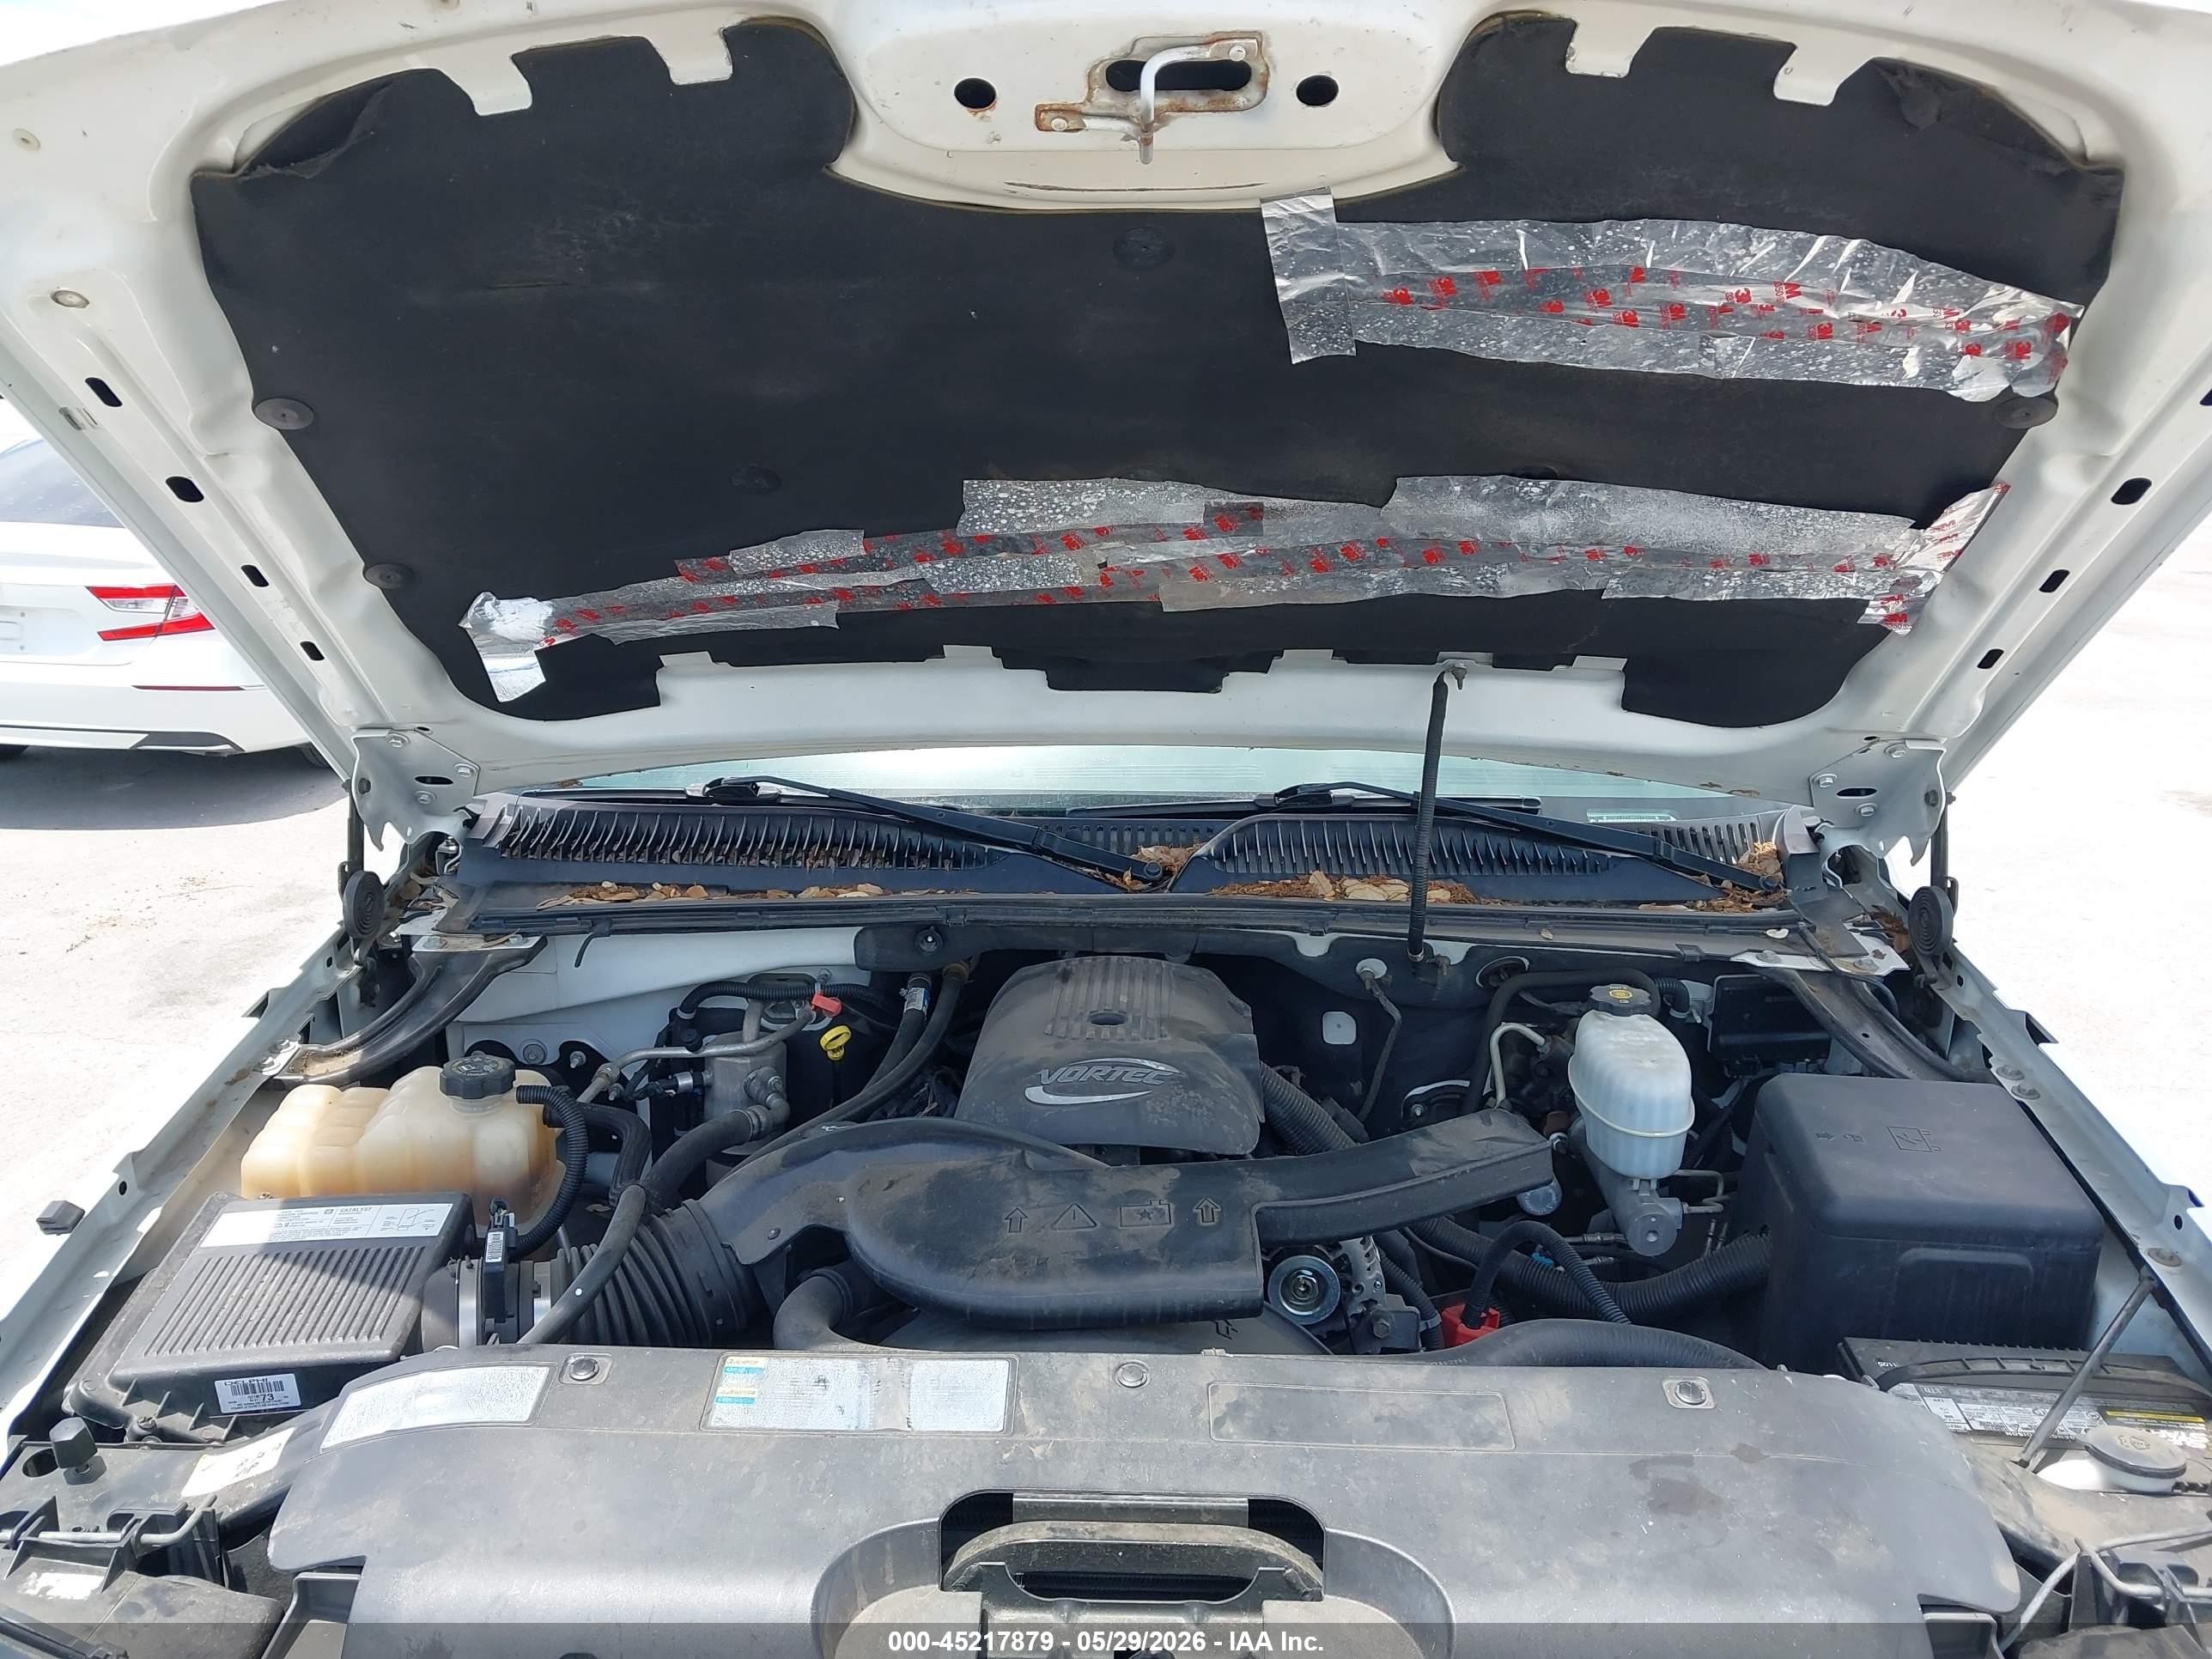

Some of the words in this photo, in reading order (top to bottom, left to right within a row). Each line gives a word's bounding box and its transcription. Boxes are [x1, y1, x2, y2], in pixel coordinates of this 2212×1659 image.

[1668, 303, 1686, 320] 3M
[1816, 322, 1833, 340] 3M
[1036, 1065, 1176, 1086] VORTEC
[224, 1377, 268, 1386] DELPHI
[261, 1393, 275, 1401] 73
